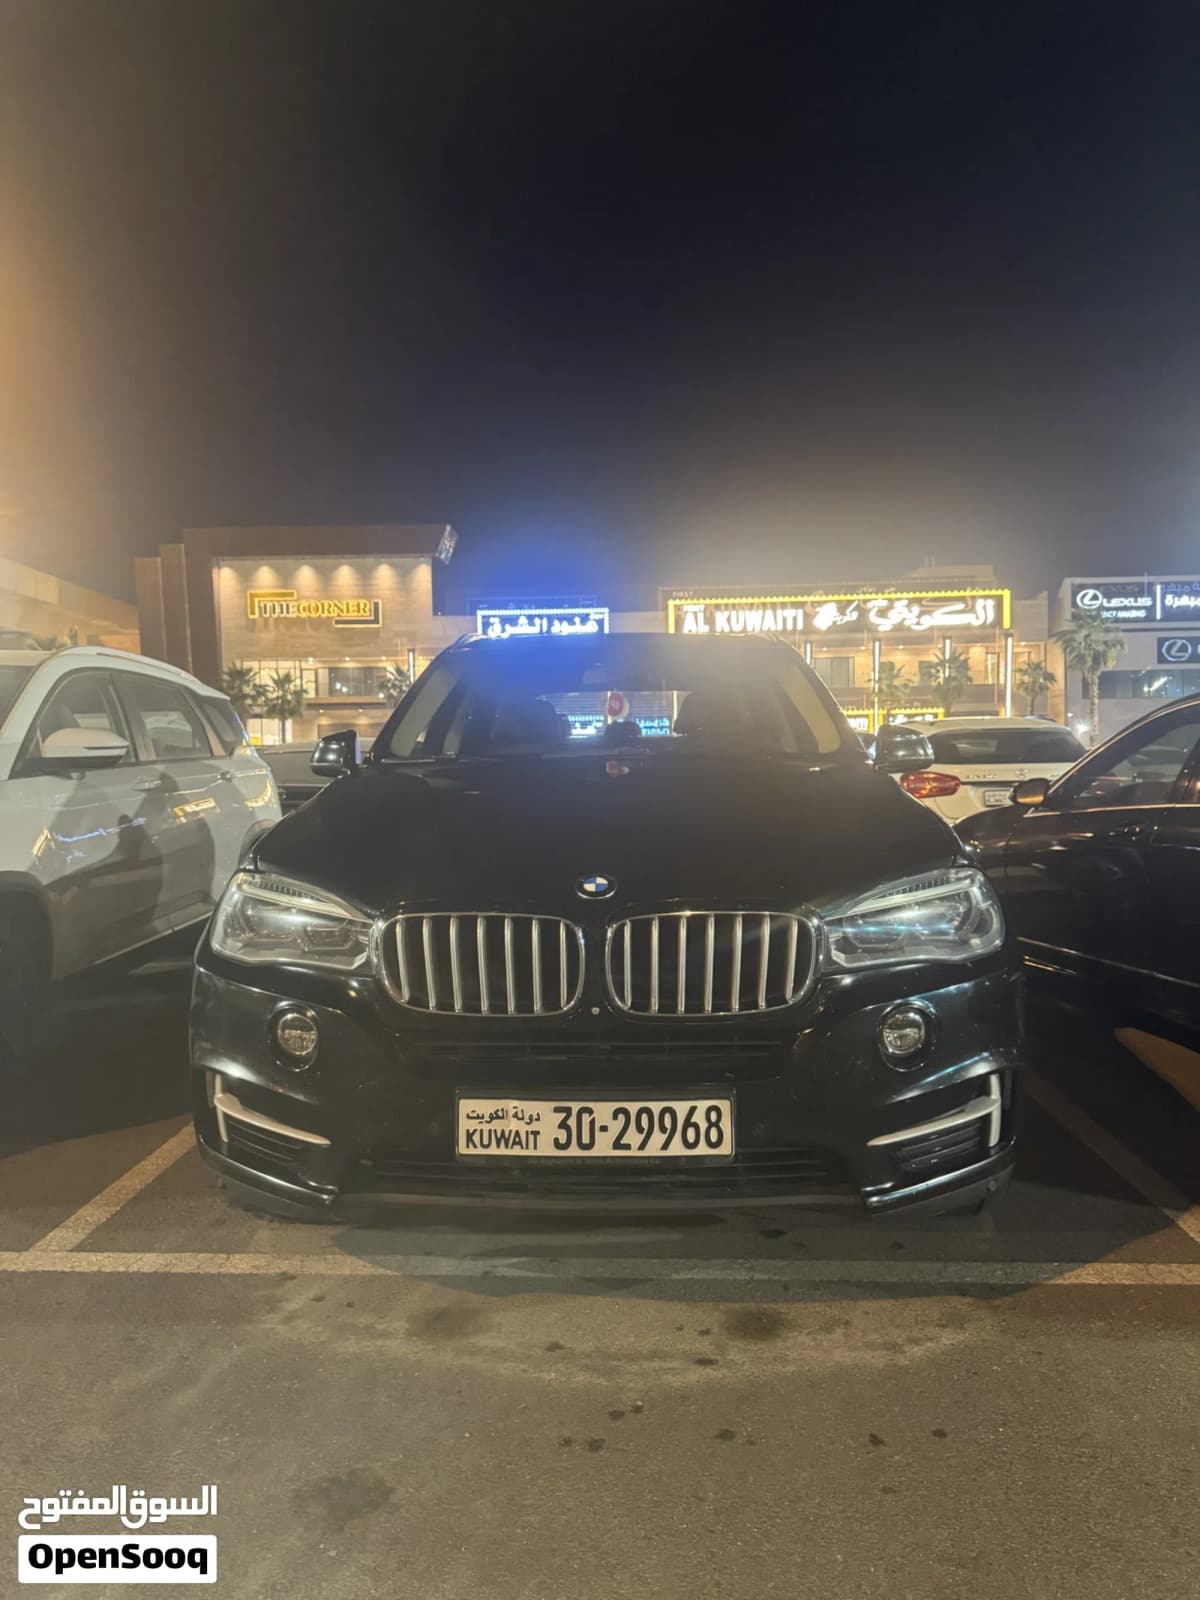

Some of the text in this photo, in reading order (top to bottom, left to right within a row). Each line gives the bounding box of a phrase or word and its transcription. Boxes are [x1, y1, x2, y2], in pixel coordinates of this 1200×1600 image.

[261, 600, 370, 618] THE CORNER
[1102, 597, 1152, 607] LEXUS
[488, 615, 548, 639] الشرق
[683, 611, 710, 633] AL
[715, 608, 804, 633] KUWAITI
[466, 1106, 541, 1125] دولة الكويت
[552, 1104, 724, 1151] 30-29968
[465, 1129, 541, 1150] KUWAIT
